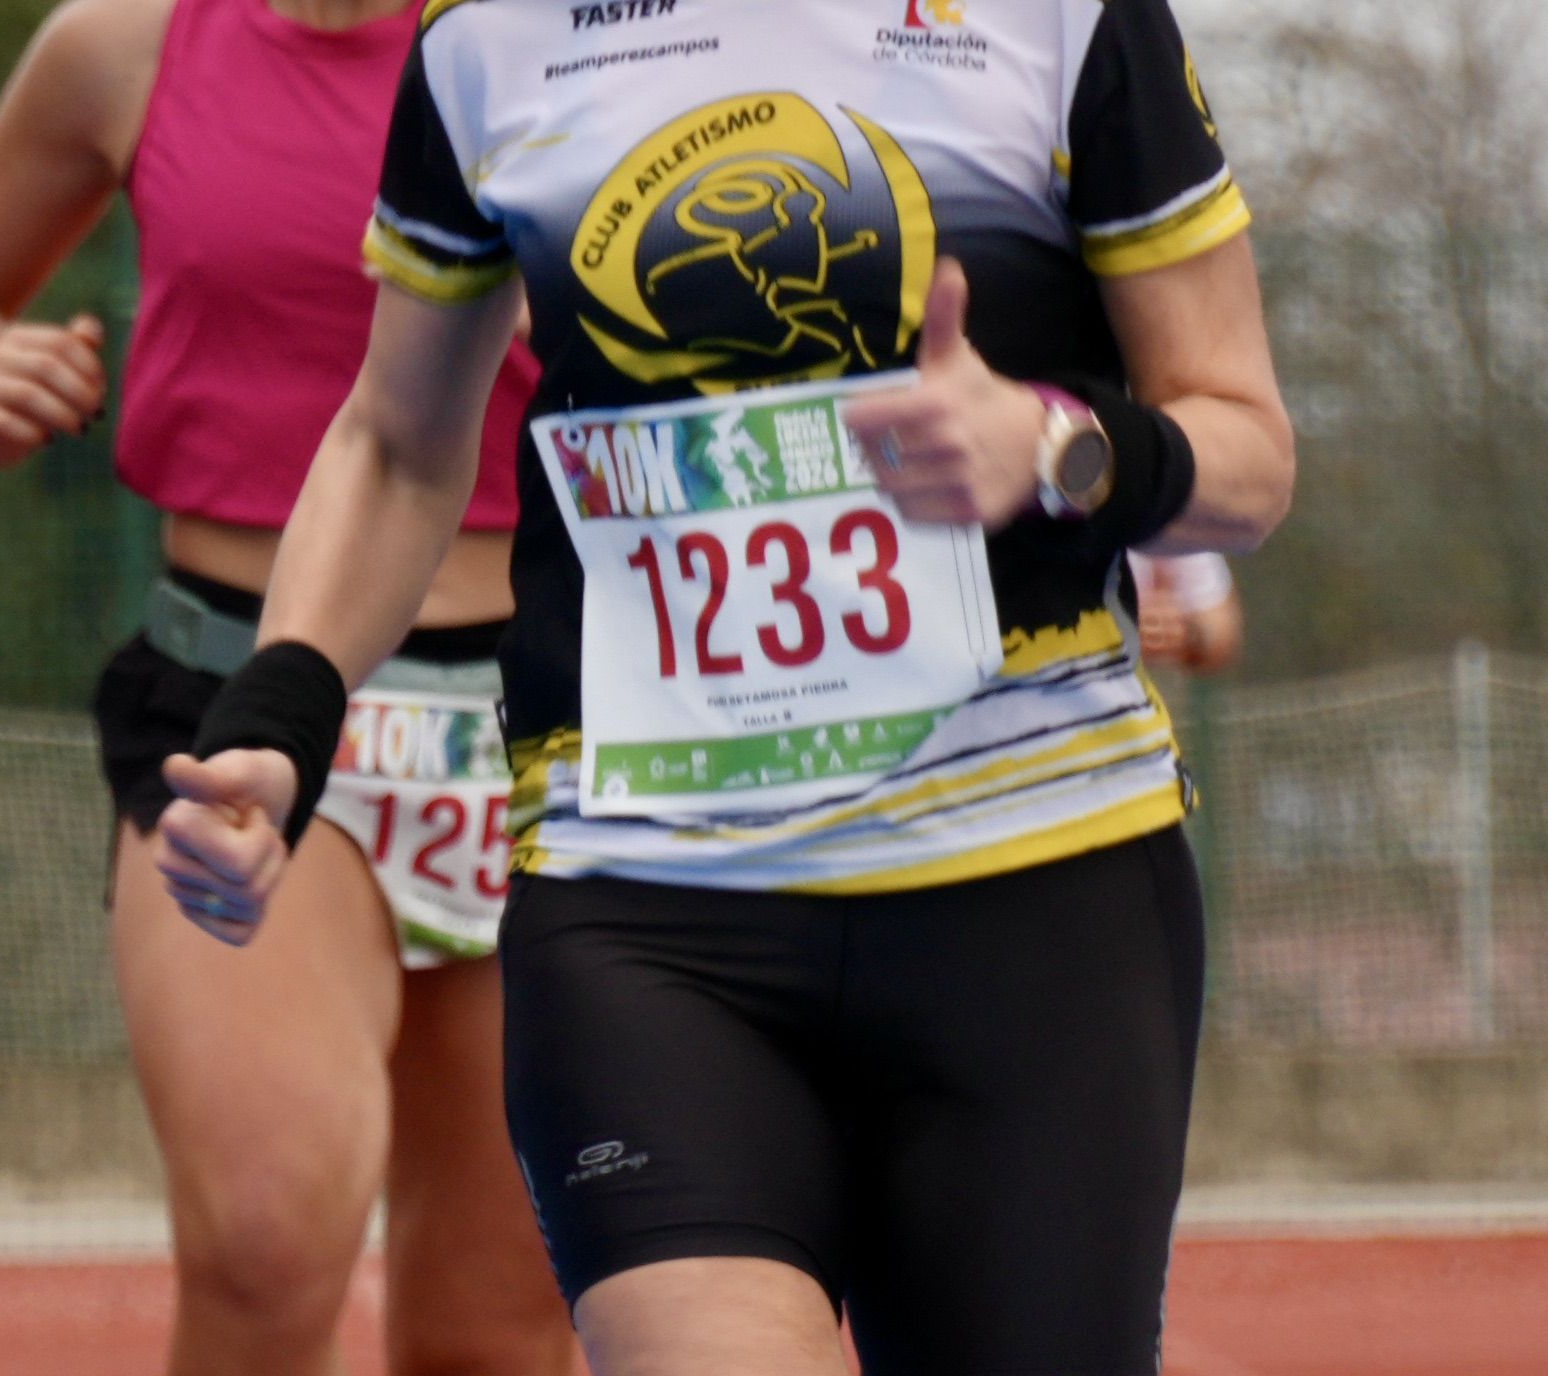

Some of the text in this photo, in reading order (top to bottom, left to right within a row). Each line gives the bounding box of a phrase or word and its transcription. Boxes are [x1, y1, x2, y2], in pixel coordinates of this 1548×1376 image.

[544, 36, 720, 82] #teamperezcampos
[875, 27, 988, 53] Diputación
[581, 100, 777, 270] CLUB ATLETISMO
[586, 423, 688, 516] 10K
[627, 508, 912, 680] 1233
[347, 703, 451, 779] 10K
